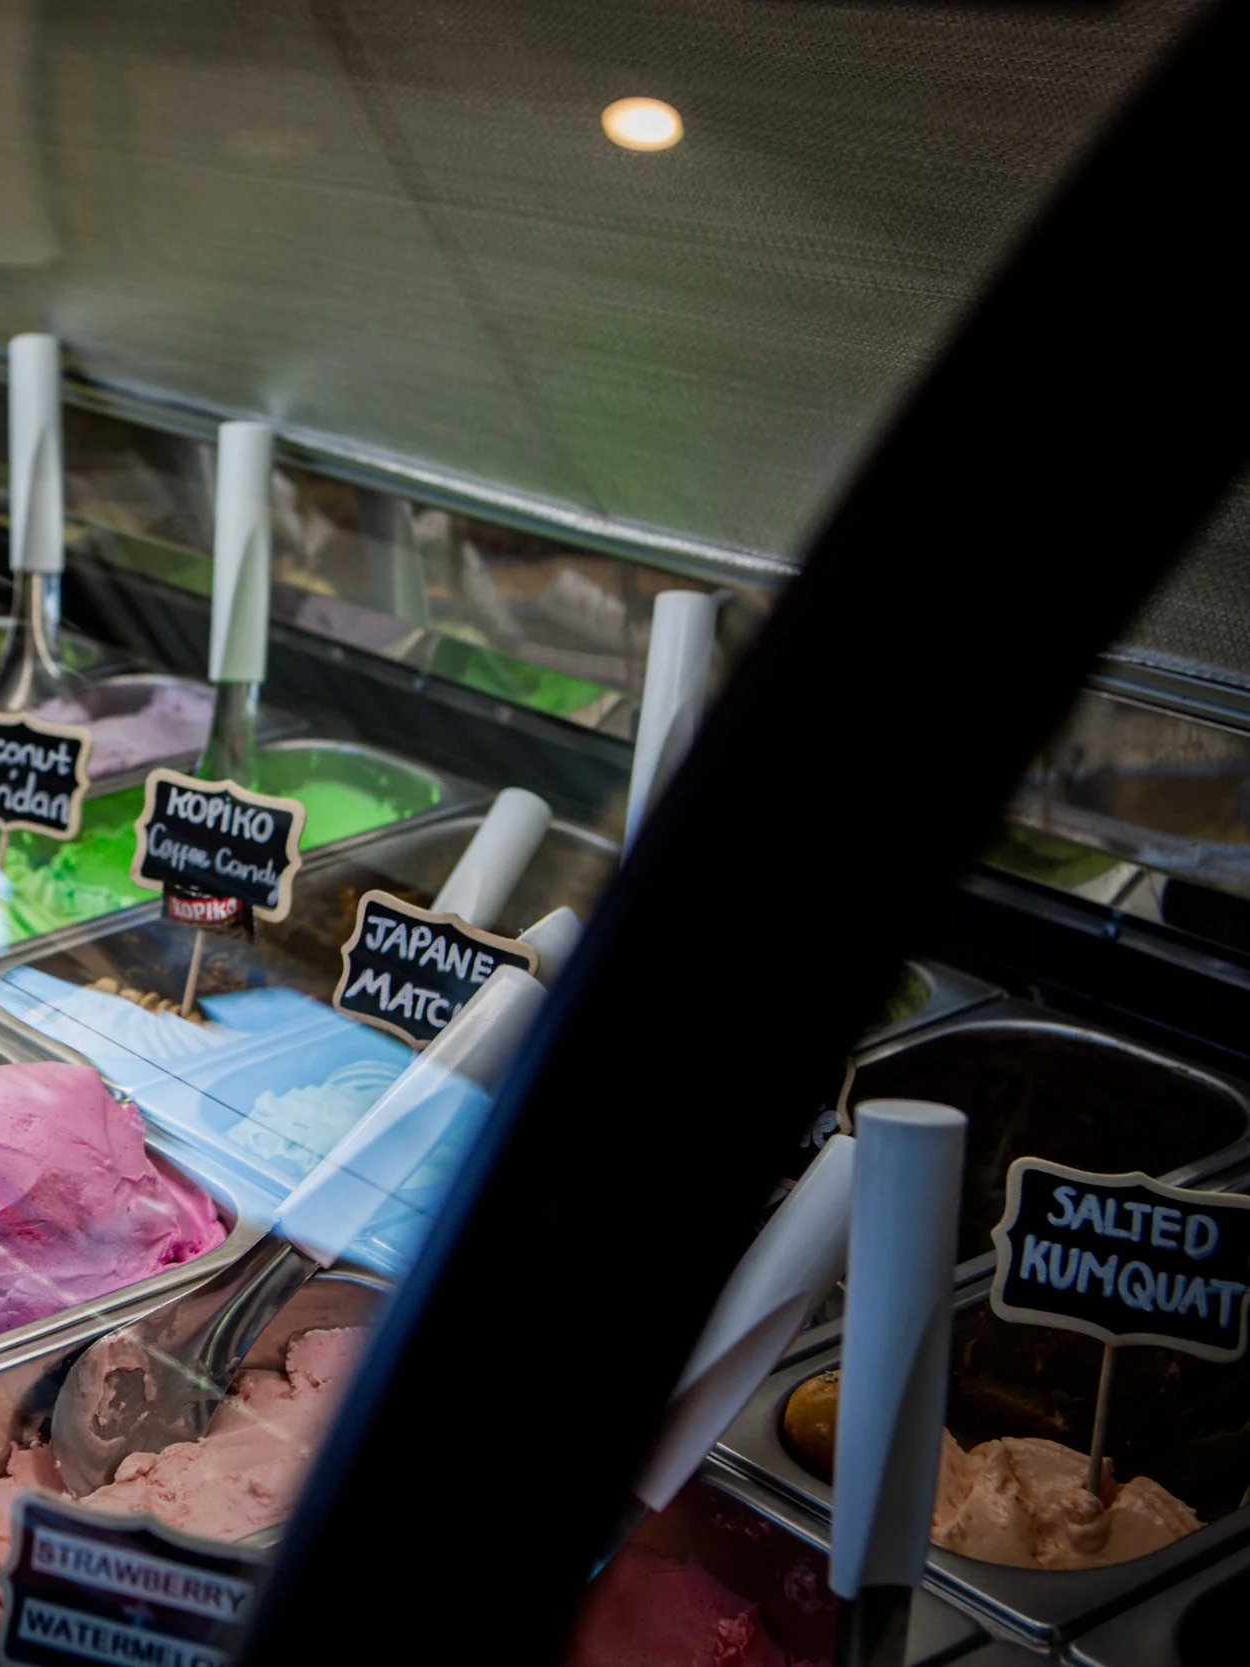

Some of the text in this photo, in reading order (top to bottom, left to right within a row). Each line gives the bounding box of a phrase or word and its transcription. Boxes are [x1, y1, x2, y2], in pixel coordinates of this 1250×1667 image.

[365, 915, 494, 984] JAPANE
[344, 968, 465, 1029] MATC
[1047, 1185, 1219, 1259] SALTED
[1019, 1234, 1247, 1328] KUMQUAT
[36, 1539, 247, 1613] STRAWBERRY
[26, 1608, 223, 1667] WATERMELO
